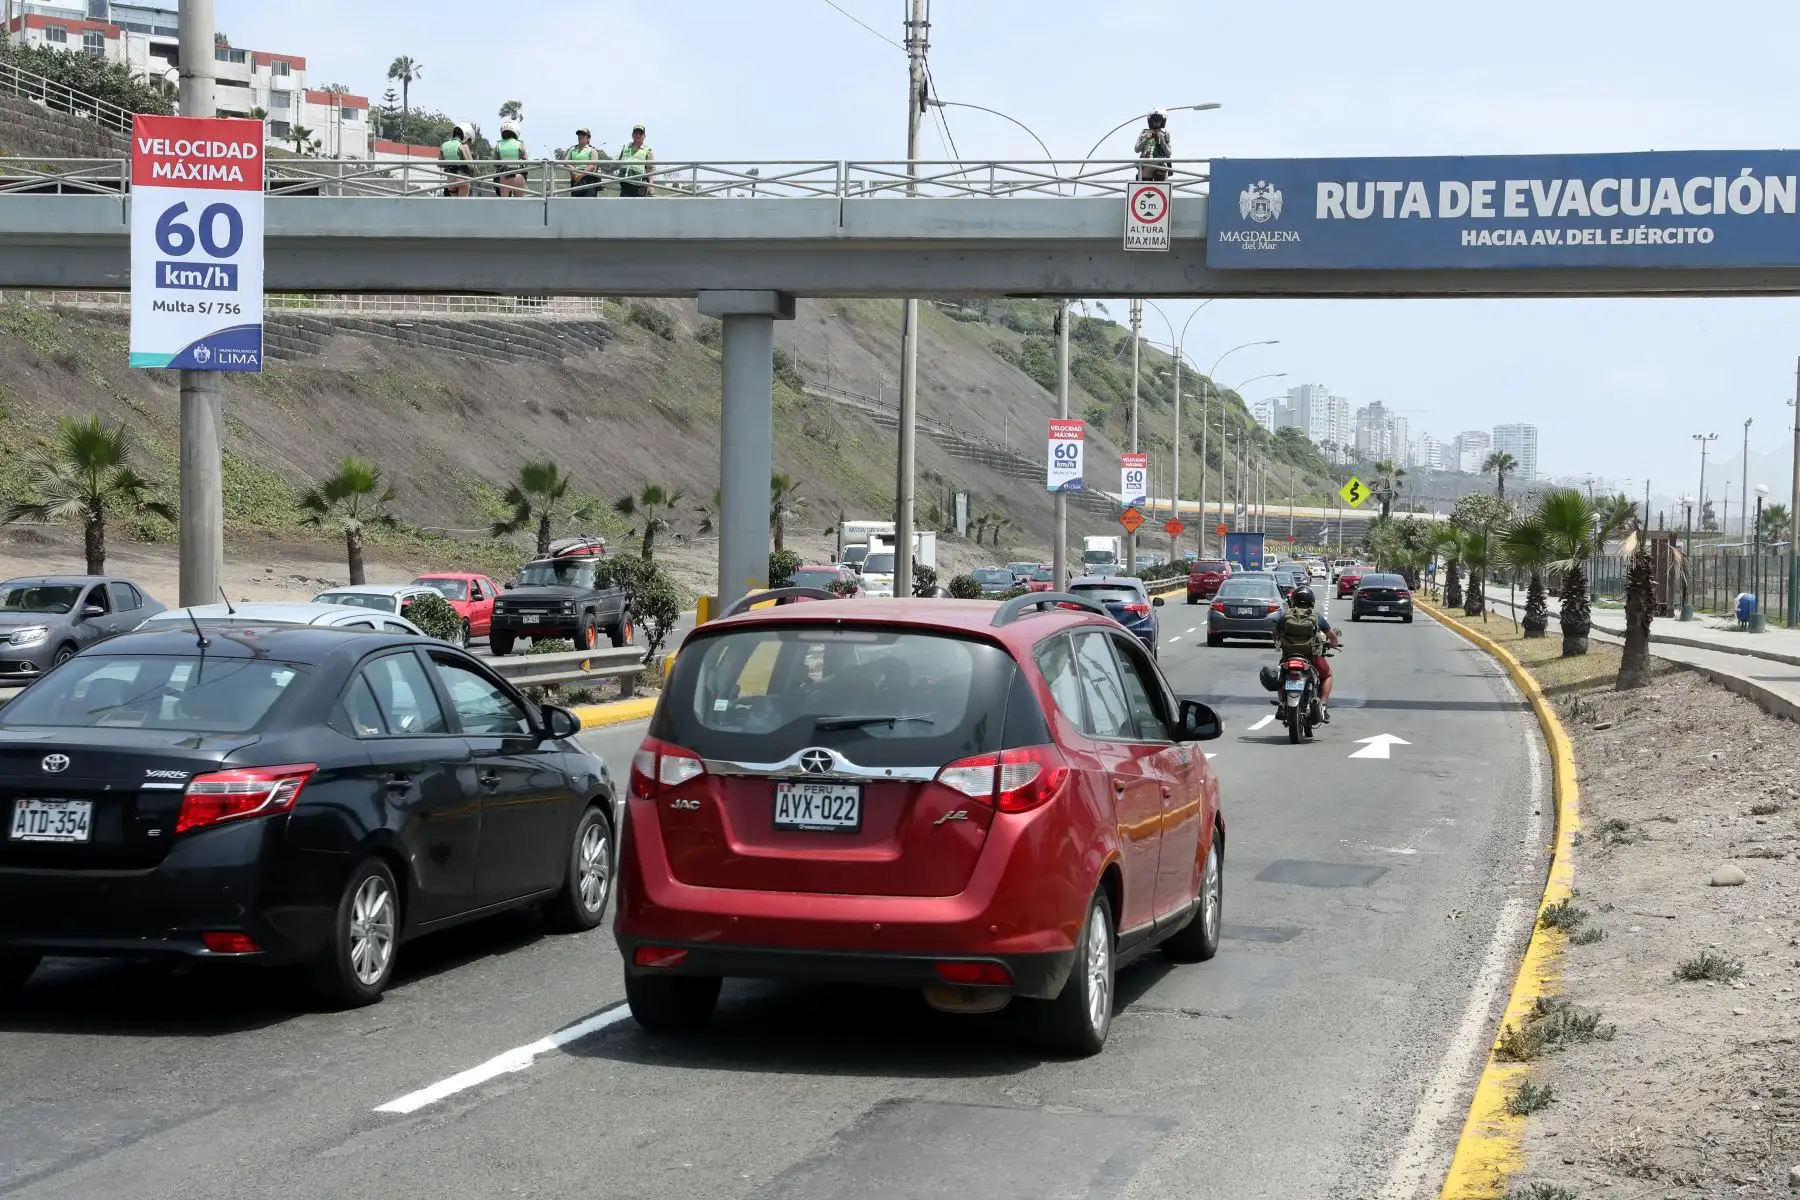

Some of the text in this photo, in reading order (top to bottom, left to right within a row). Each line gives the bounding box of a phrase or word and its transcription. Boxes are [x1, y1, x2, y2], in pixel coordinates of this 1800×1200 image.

[138, 137, 258, 160] VELOCIDAD
[152, 158, 244, 183] MÁXIMA
[1316, 167, 1797, 219] RUTA DE EVACUACIÓN
[1139, 200, 1147, 210] 5
[155, 200, 244, 259] 60
[1130, 225, 1164, 234] ALTURA
[1219, 230, 1301, 242] MAGDALENA
[1461, 224, 1715, 246] HACIA AV. DEL EJÉRCITO
[1127, 236, 1167, 246] MAXIMA
[1241, 241, 1277, 250] del Mar
[165, 264, 229, 289] km/h
[152, 299, 241, 316] Multa S/ 756
[219, 352, 259, 365] LIMA
[1054, 443, 1079, 460] 60
[1056, 460, 1075, 468] km/h
[1126, 470, 1143, 483] 60
[144, 769, 190, 779] YARIS
[803, 785, 834, 794] PERU
[670, 798, 701, 810] JAC
[778, 793, 856, 821] AYX-022
[15, 809, 87, 835] ATD-354
